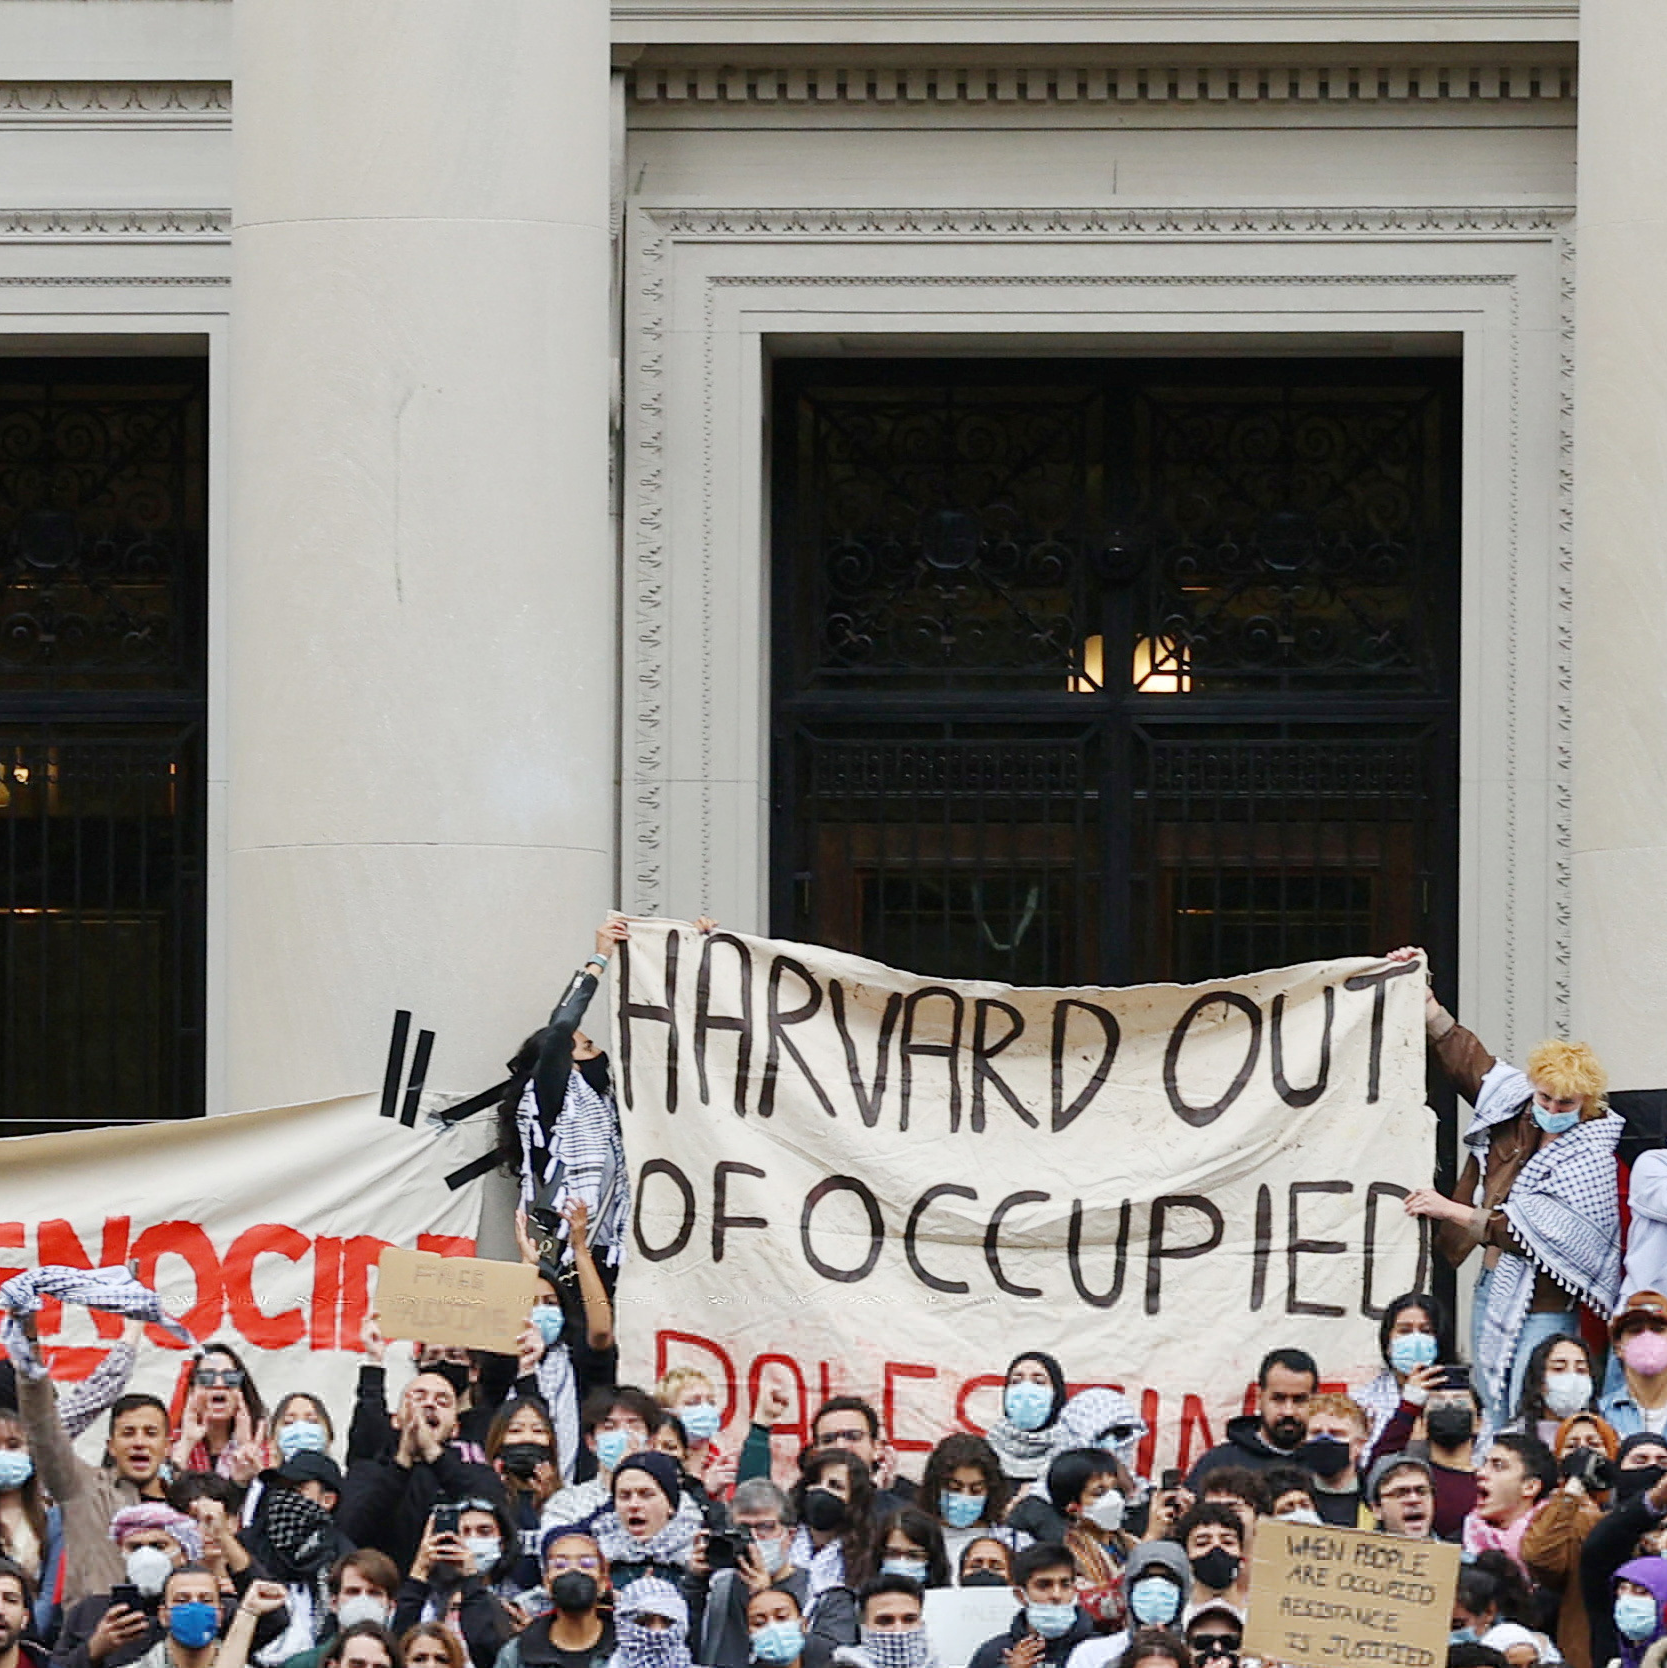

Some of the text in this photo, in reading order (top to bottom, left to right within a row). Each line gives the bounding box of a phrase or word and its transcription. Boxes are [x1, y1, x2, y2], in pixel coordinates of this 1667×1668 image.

[617, 927, 1420, 1133] HARVARD OUT
[634, 1158, 1432, 1321] OF OCCUPIED
[1284, 1564, 1330, 1587] ARE
[1285, 1535, 1431, 1577] WHEN PEOPLE
